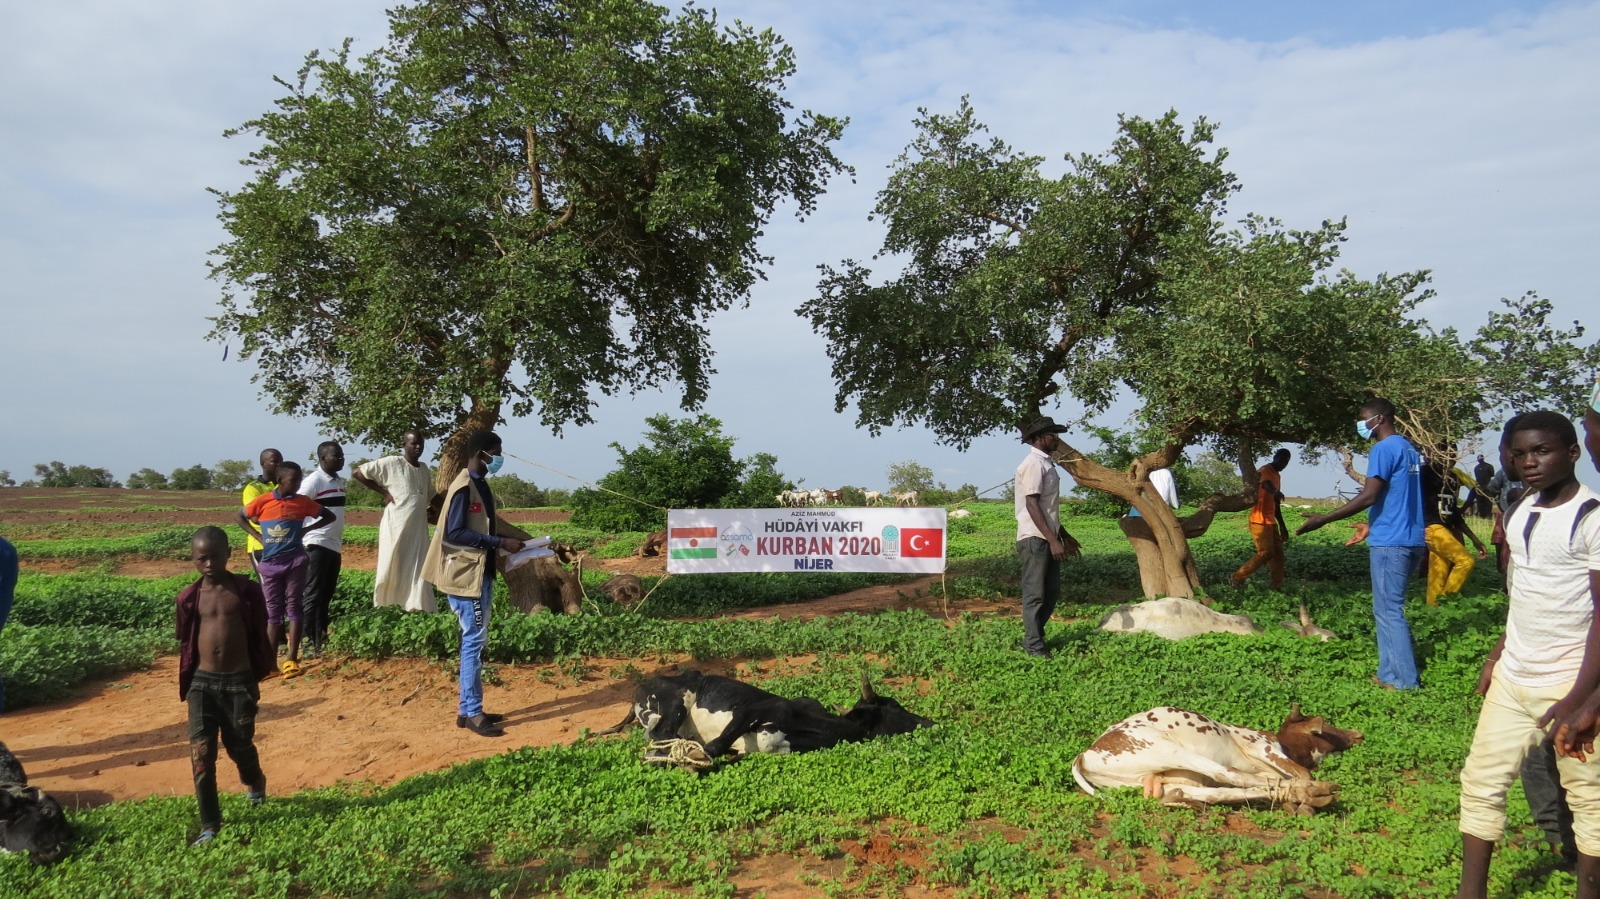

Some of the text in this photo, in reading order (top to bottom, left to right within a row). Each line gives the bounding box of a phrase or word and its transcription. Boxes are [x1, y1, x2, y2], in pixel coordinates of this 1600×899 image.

[764, 518, 863, 532] HÜDÂYİ VAKFI
[756, 536, 881, 556] KURBAN 2020
[794, 556, 834, 570] NİJER
